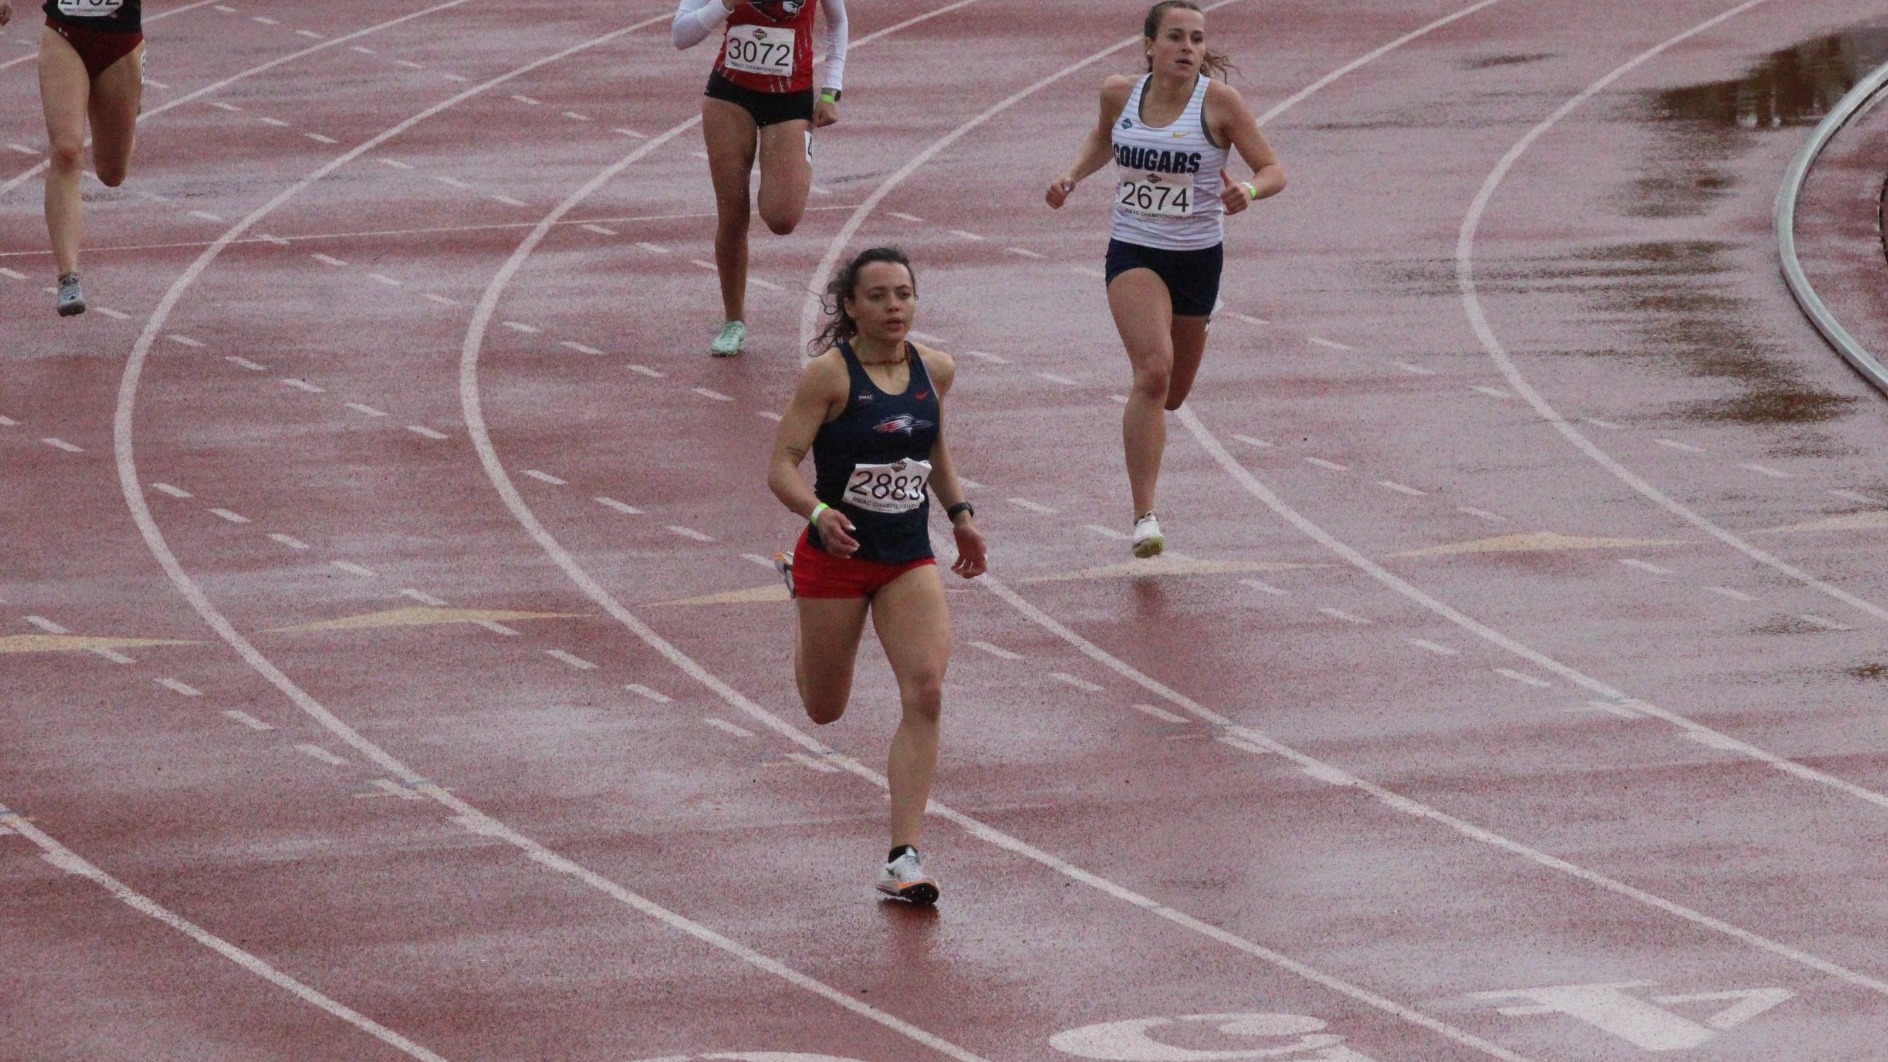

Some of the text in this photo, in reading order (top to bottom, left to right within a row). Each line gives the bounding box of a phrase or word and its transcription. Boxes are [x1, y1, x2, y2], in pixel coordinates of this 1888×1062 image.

[728, 37, 790, 67] 3072
[1114, 143, 1202, 174] COUGARS
[1121, 181, 1190, 213] 2674
[849, 470, 923, 501] 2883
[852, 496, 872, 506] RMAC
